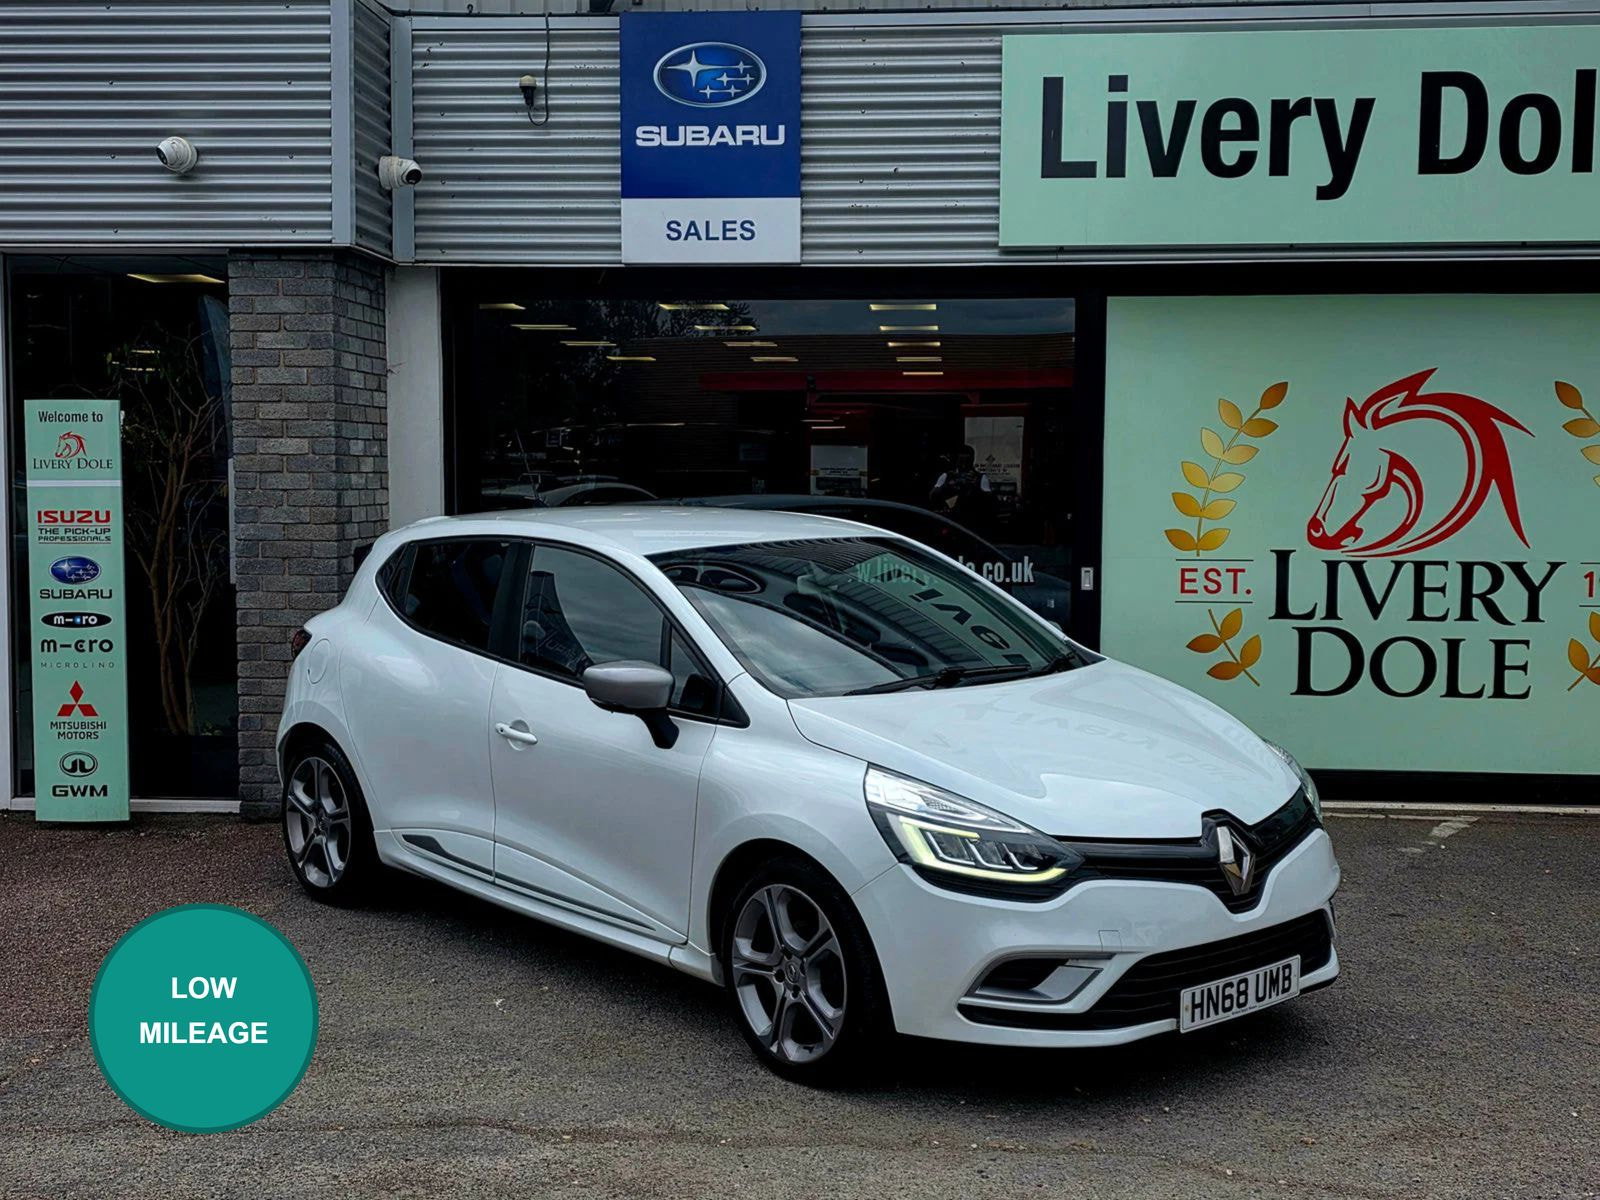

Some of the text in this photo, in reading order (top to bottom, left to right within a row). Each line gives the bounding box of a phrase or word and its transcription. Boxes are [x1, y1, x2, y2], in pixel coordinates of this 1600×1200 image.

[635, 124, 785, 147] SUBARU
[1041, 74, 1376, 200] Livery
[666, 220, 756, 241] SALES
[38, 411, 103, 422] Welcome to
[33, 458, 113, 469] LIVERY DOLE
[37, 510, 110, 523] ISUZU
[38, 527, 110, 535] THE PICK-UP
[1179, 568, 1252, 595] EST.
[1268, 549, 1567, 626] LIVERY
[1583, 571, 1600, 598] 1
[39, 588, 113, 600] SUBARU
[1290, 627, 1532, 700] DOLE
[50, 721, 107, 730] MITSUBISHI
[57, 731, 99, 740] MOTORS
[52, 784, 108, 798] GWM
[1190, 962, 1292, 1023] HN68 UMB
